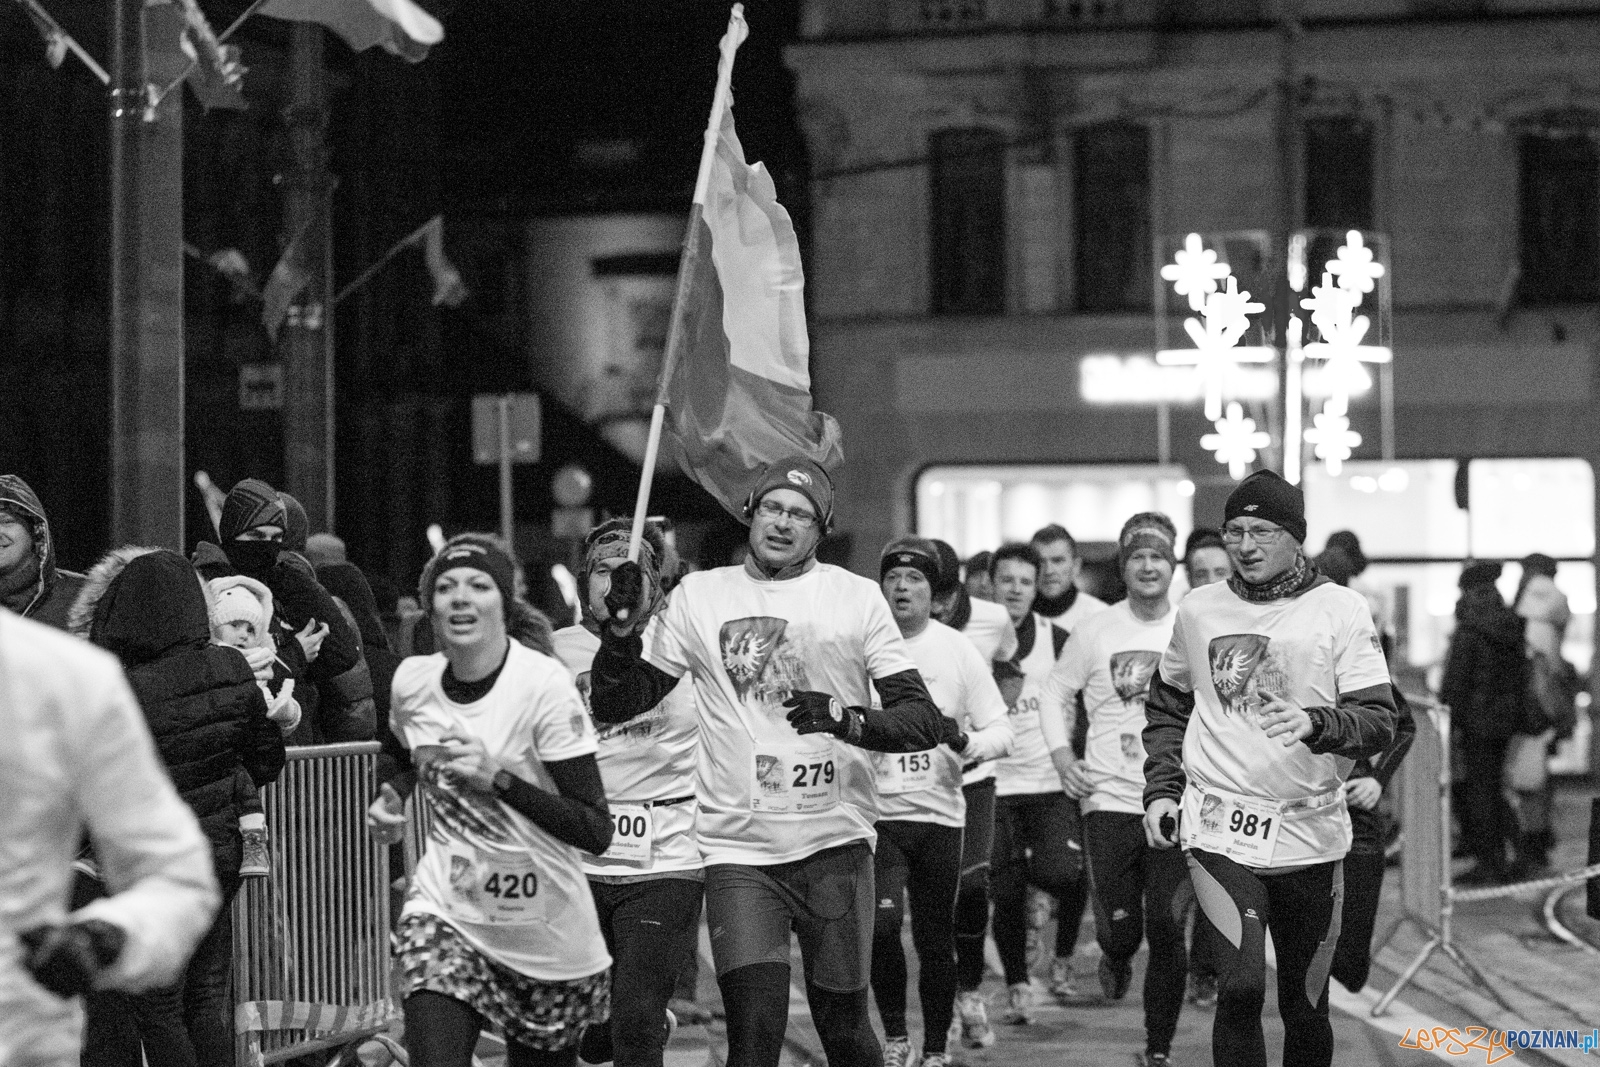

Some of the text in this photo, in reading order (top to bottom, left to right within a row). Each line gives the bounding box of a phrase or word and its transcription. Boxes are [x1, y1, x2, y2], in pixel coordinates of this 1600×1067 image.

[792, 760, 835, 788] 279
[898, 753, 930, 773] 153
[611, 814, 647, 838] 00
[1229, 809, 1273, 840] 981
[1233, 838, 1258, 850] Marcin
[483, 872, 538, 899] 420
